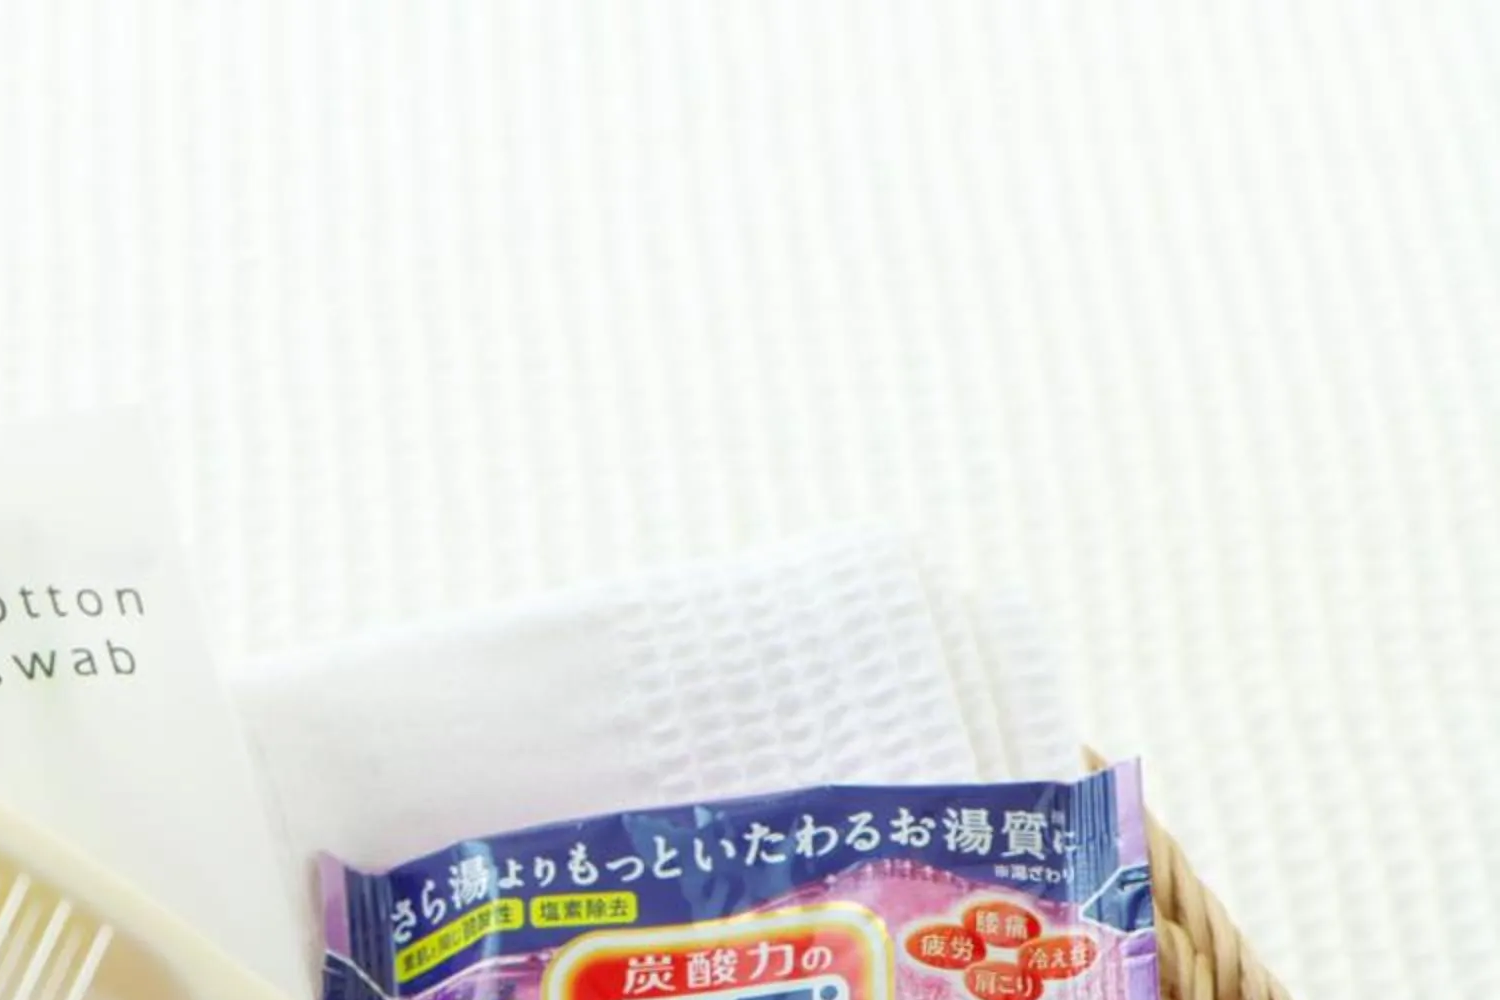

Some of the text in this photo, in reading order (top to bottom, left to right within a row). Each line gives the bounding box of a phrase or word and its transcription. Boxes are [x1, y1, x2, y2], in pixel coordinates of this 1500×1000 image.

[540, 898, 629, 922] 塩素除去
[921, 935, 974, 961] 疲労
[623, 942, 834, 995] 炭酸力の
